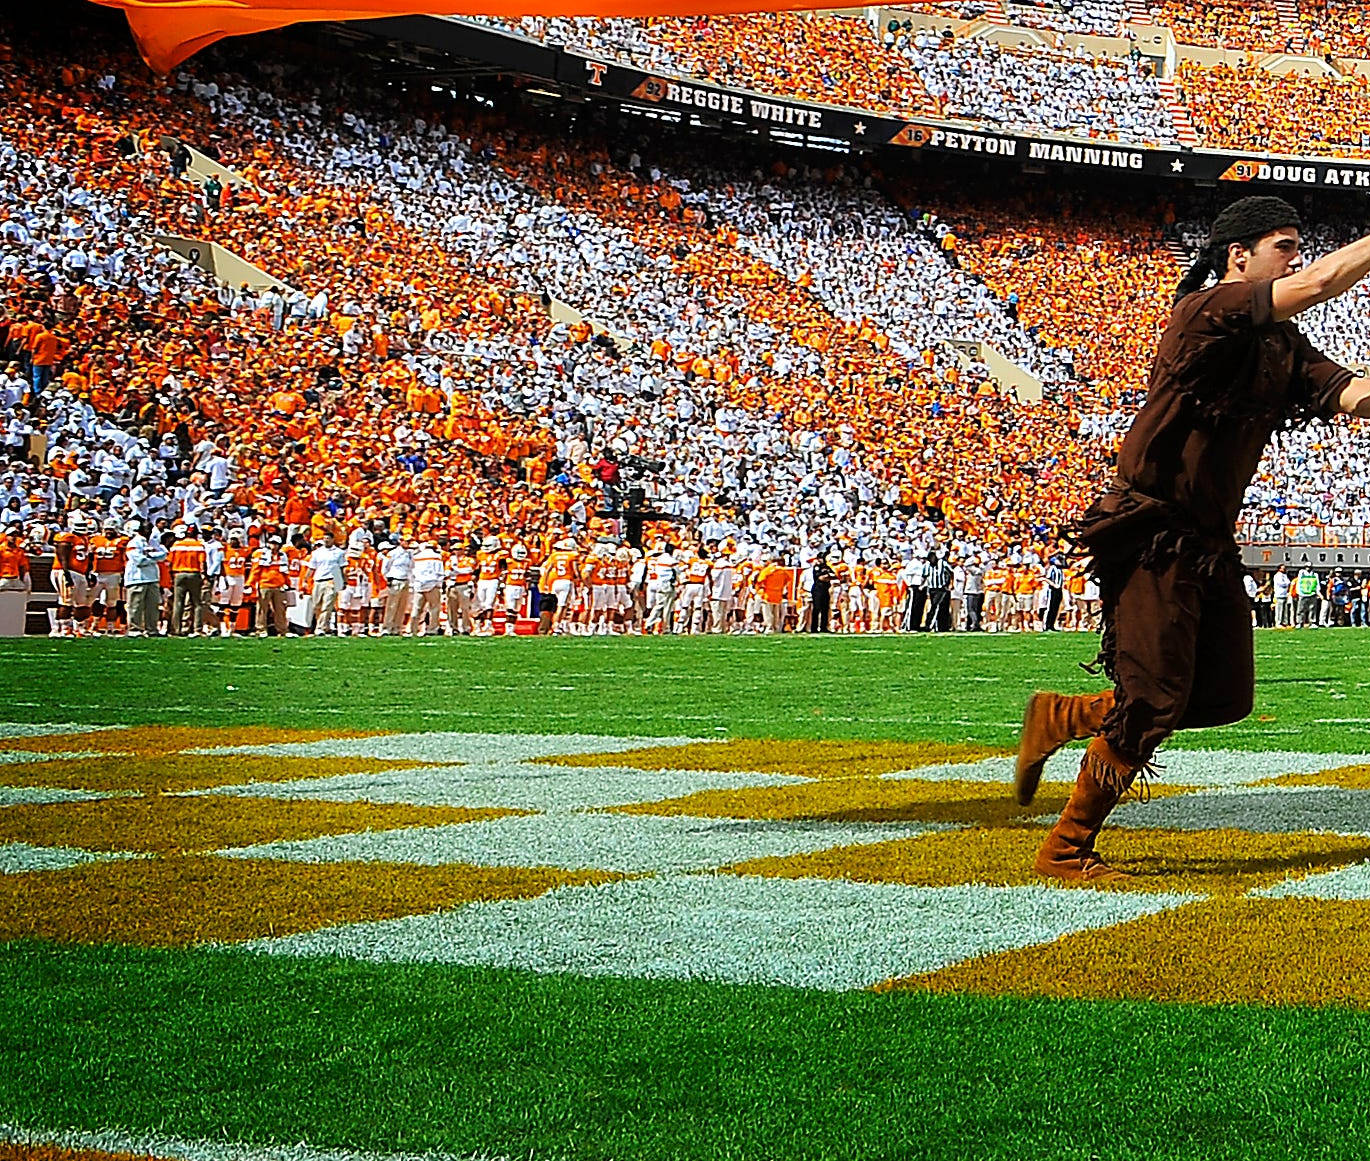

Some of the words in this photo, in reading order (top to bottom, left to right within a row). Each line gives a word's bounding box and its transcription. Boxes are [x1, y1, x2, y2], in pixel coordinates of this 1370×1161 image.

[585, 60, 608, 86] T
[645, 80, 662, 100] 92
[666, 83, 744, 115] REGGIE
[750, 100, 823, 128] WHITE
[907, 129, 923, 143] 16
[930, 130, 1016, 156] PEYTON
[1029, 144, 1143, 169] MANNING
[1236, 162, 1252, 179] 91
[1258, 165, 1316, 185] DOUG
